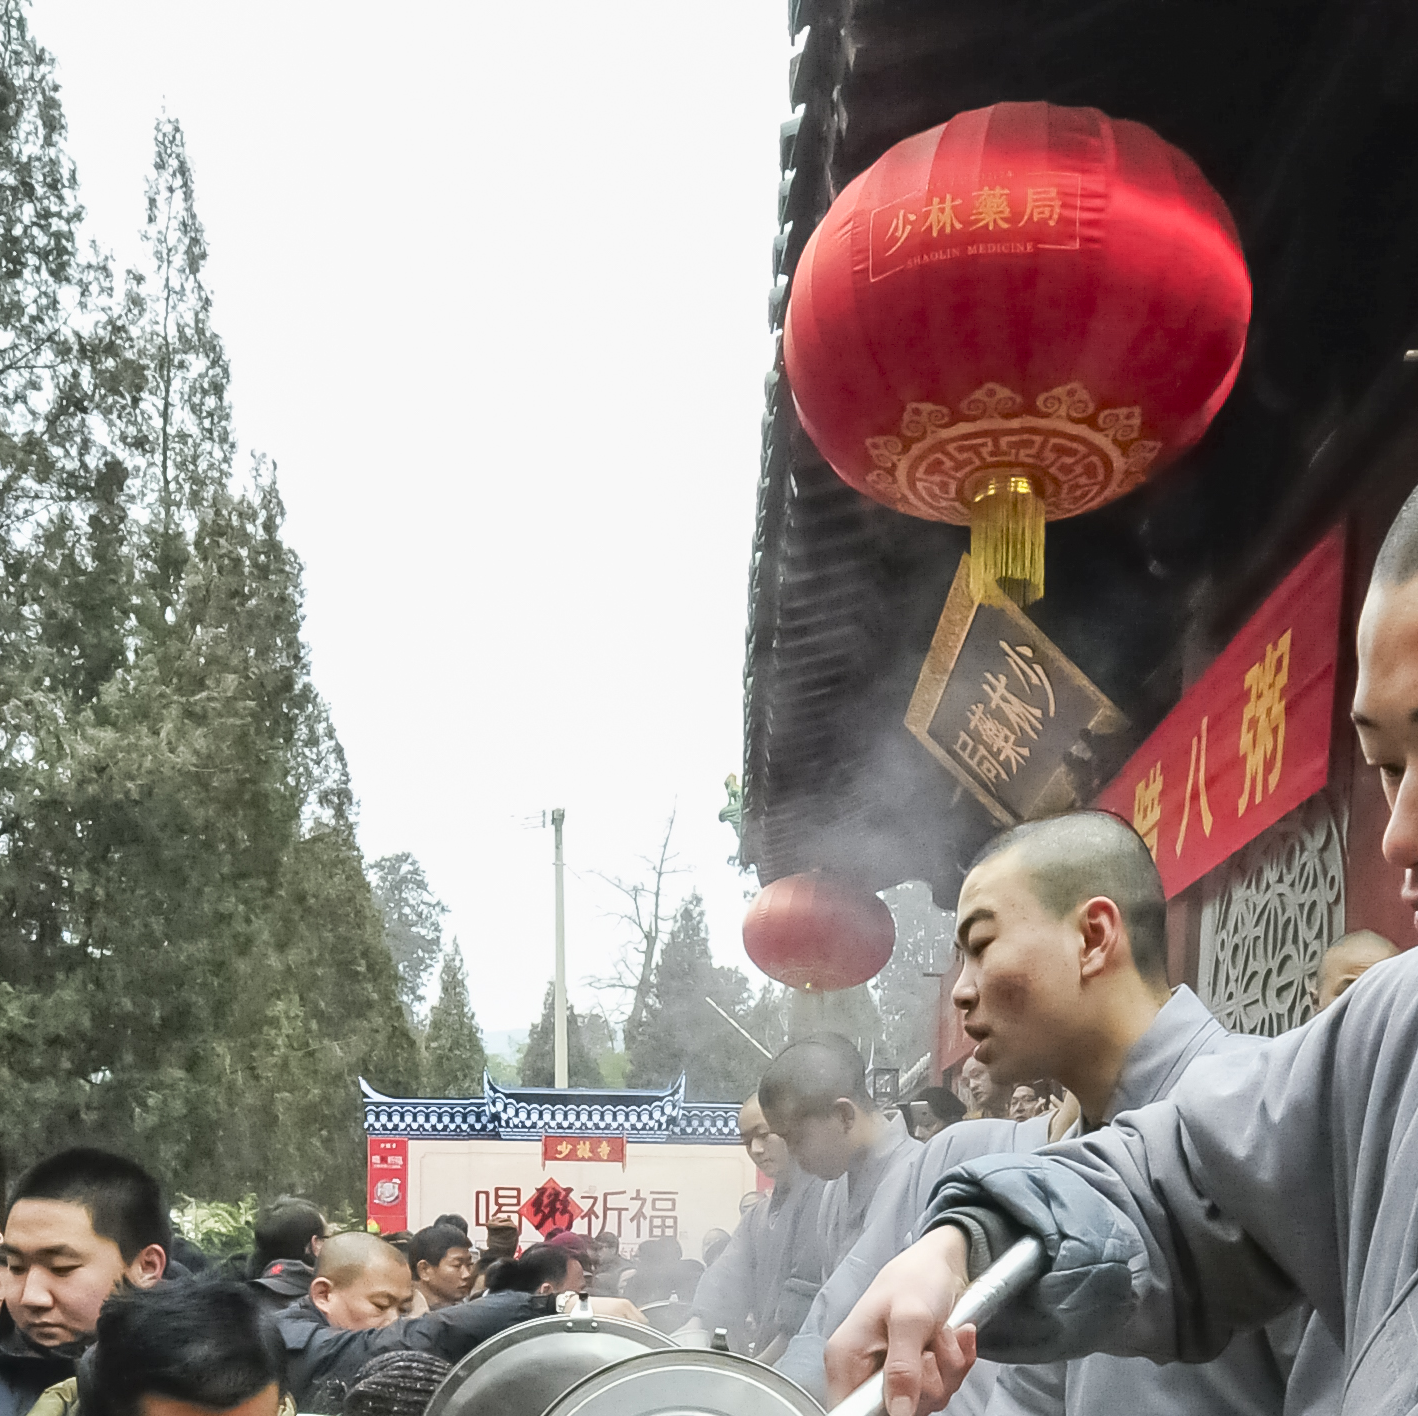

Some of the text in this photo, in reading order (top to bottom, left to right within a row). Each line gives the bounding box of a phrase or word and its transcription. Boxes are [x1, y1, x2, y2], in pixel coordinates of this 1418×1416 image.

[884, 185, 1062, 257] 少林藥局
[906, 240, 1034, 269] SHAOLIN MEDICINE
[953, 640, 1056, 797] 少林藥局
[555, 1140, 611, 1160] 少林寺
